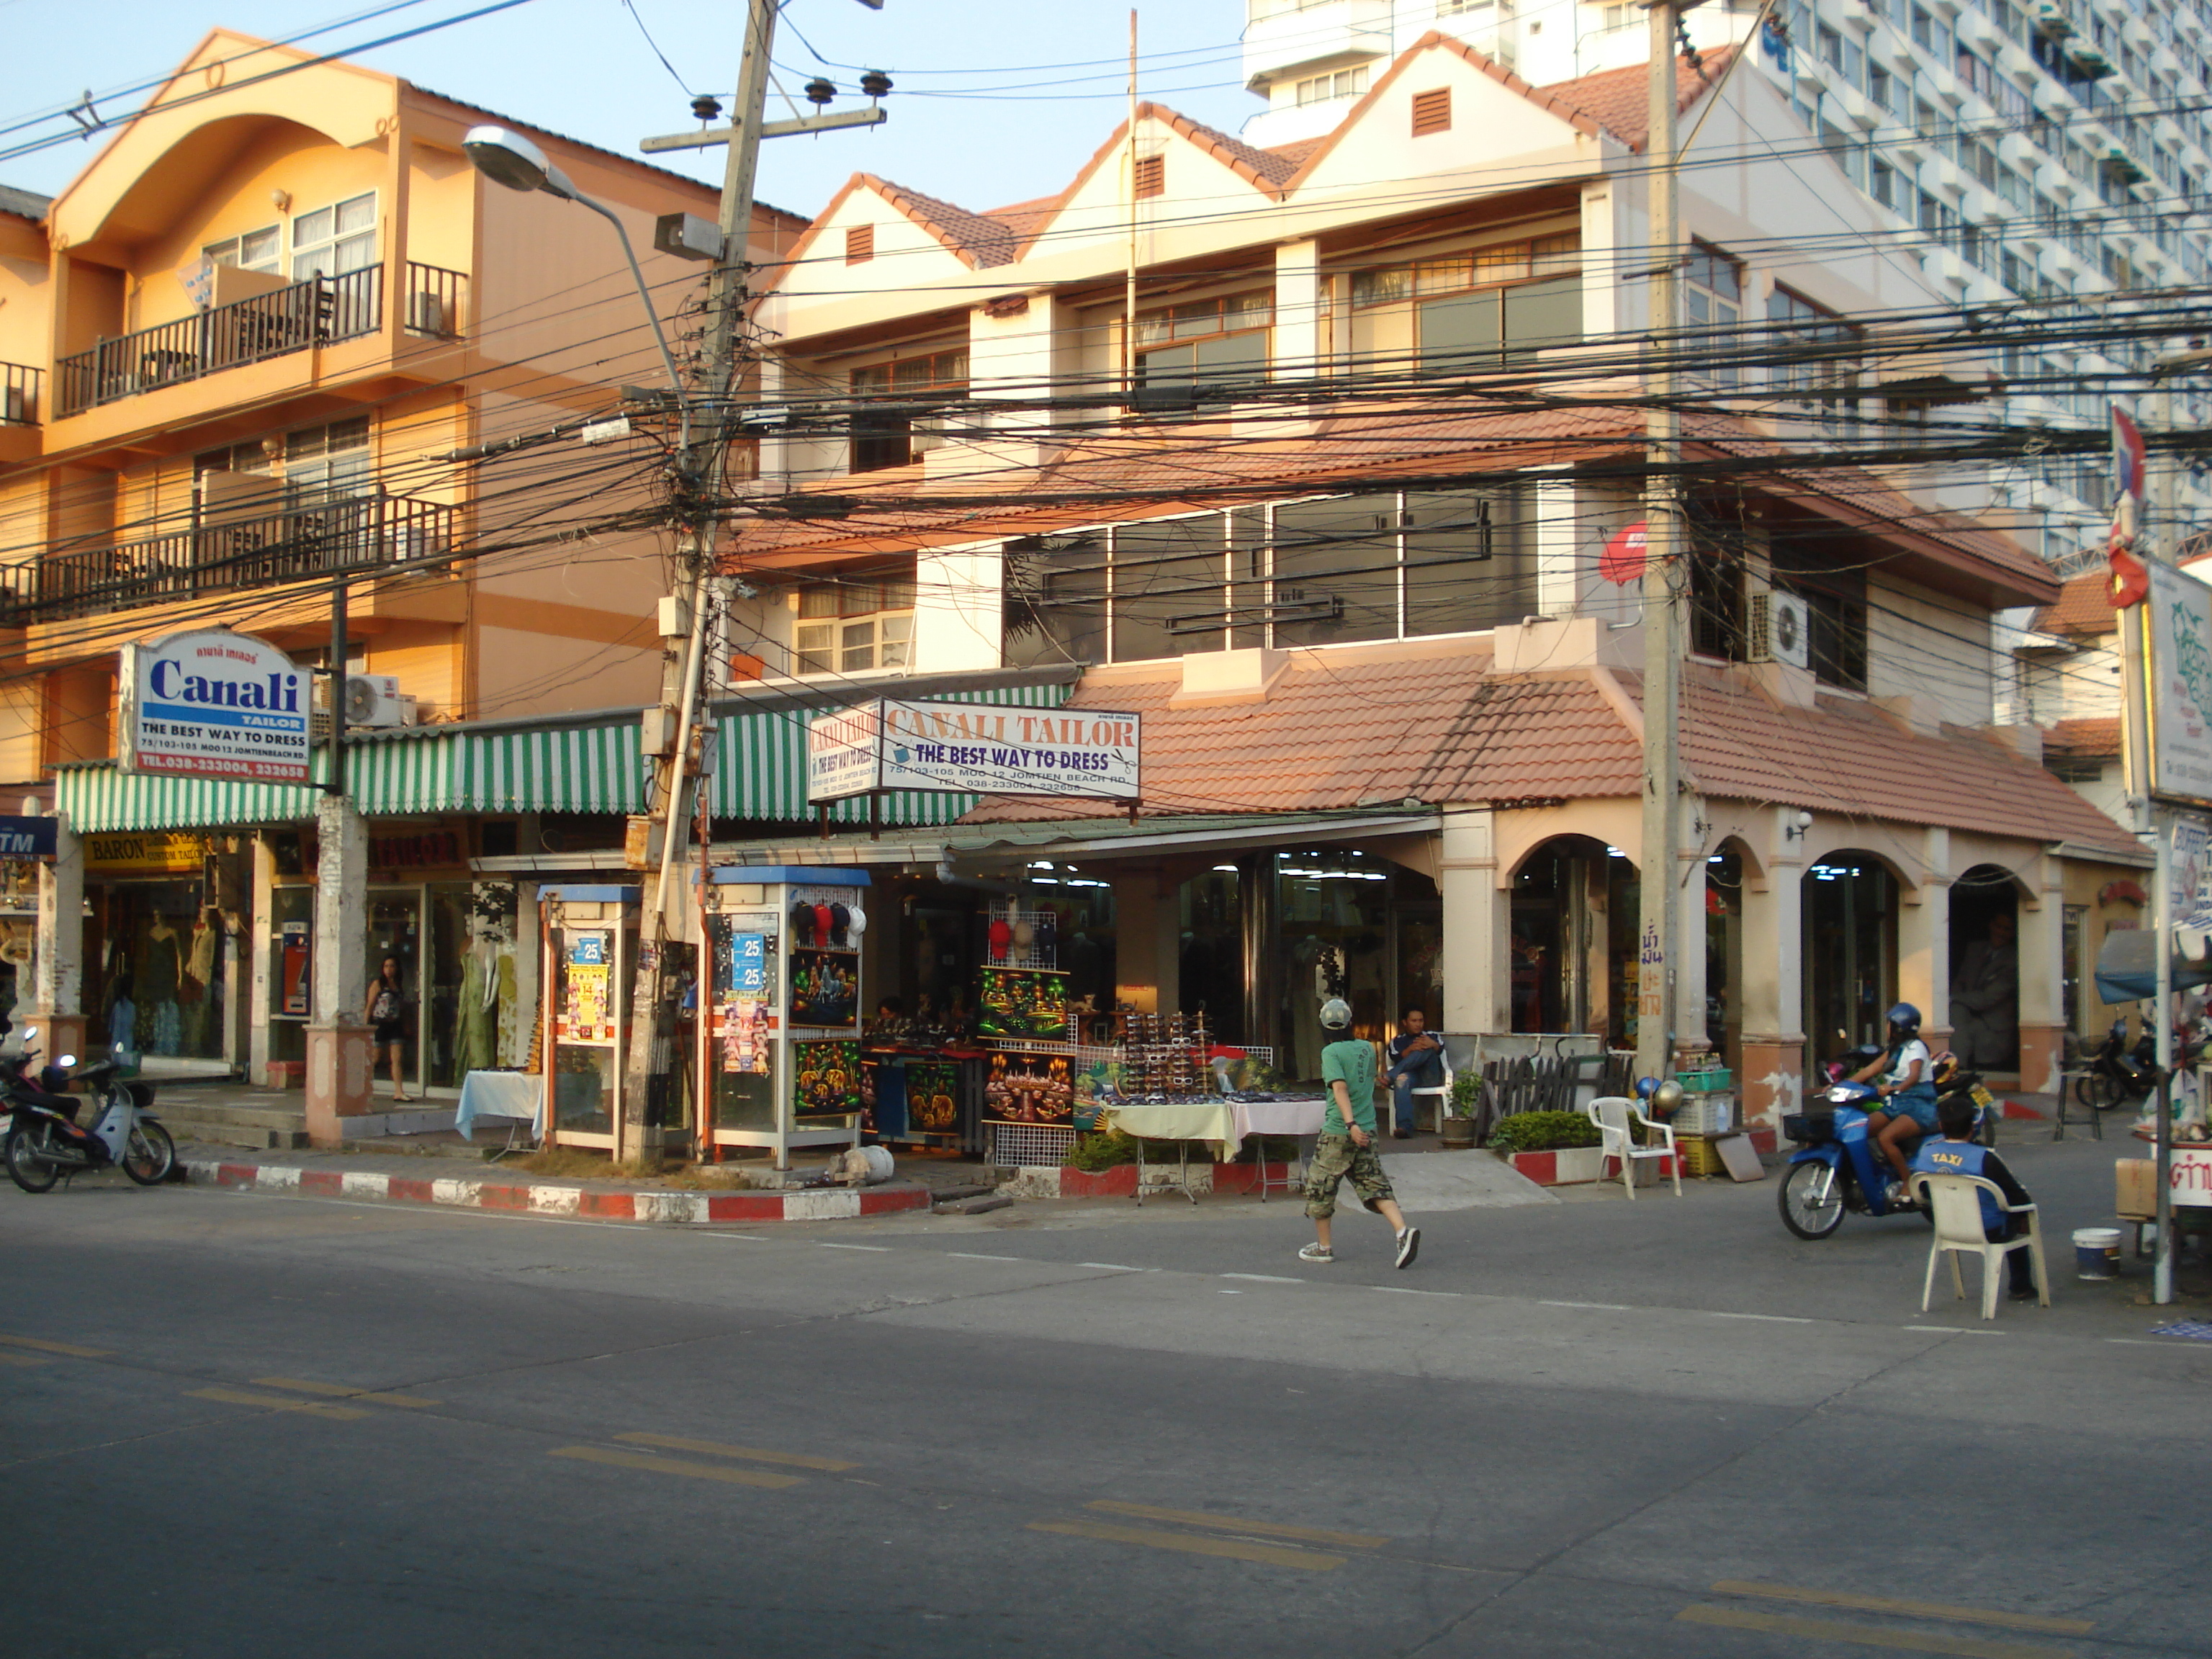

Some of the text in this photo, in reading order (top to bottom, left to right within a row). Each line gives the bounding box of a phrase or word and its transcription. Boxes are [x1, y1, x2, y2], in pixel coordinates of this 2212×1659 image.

[150, 659, 300, 713] Canali
[242, 716, 300, 729] TAILOR
[887, 709, 1136, 747] CANALI TAILOR
[141, 723, 305, 746] THE BEST WAY TO DRESS
[811, 710, 878, 753] CANALI TAILOR
[827, 754, 837, 773] BEST
[838, 750, 849, 769] WAY
[850, 748, 857, 767] TO
[857, 745, 872, 765] DRESS
[916, 745, 1109, 770] THE BEST WAY TO DRESS
[256, 763, 305, 778] 232658
[889, 765, 954, 776] 75/103-105
[1010, 771, 1061, 781] JOMTIEN
[1067, 774, 1105, 783] BEACH
[1040, 783, 1081, 791] 232658
[91, 836, 145, 860] BARON
[147, 849, 204, 861] CUSTOM TAILOR
[585, 943, 598, 959] 25
[745, 940, 759, 956] 25
[745, 968, 759, 985] 25
[1931, 1153, 1964, 1166] TAXI
